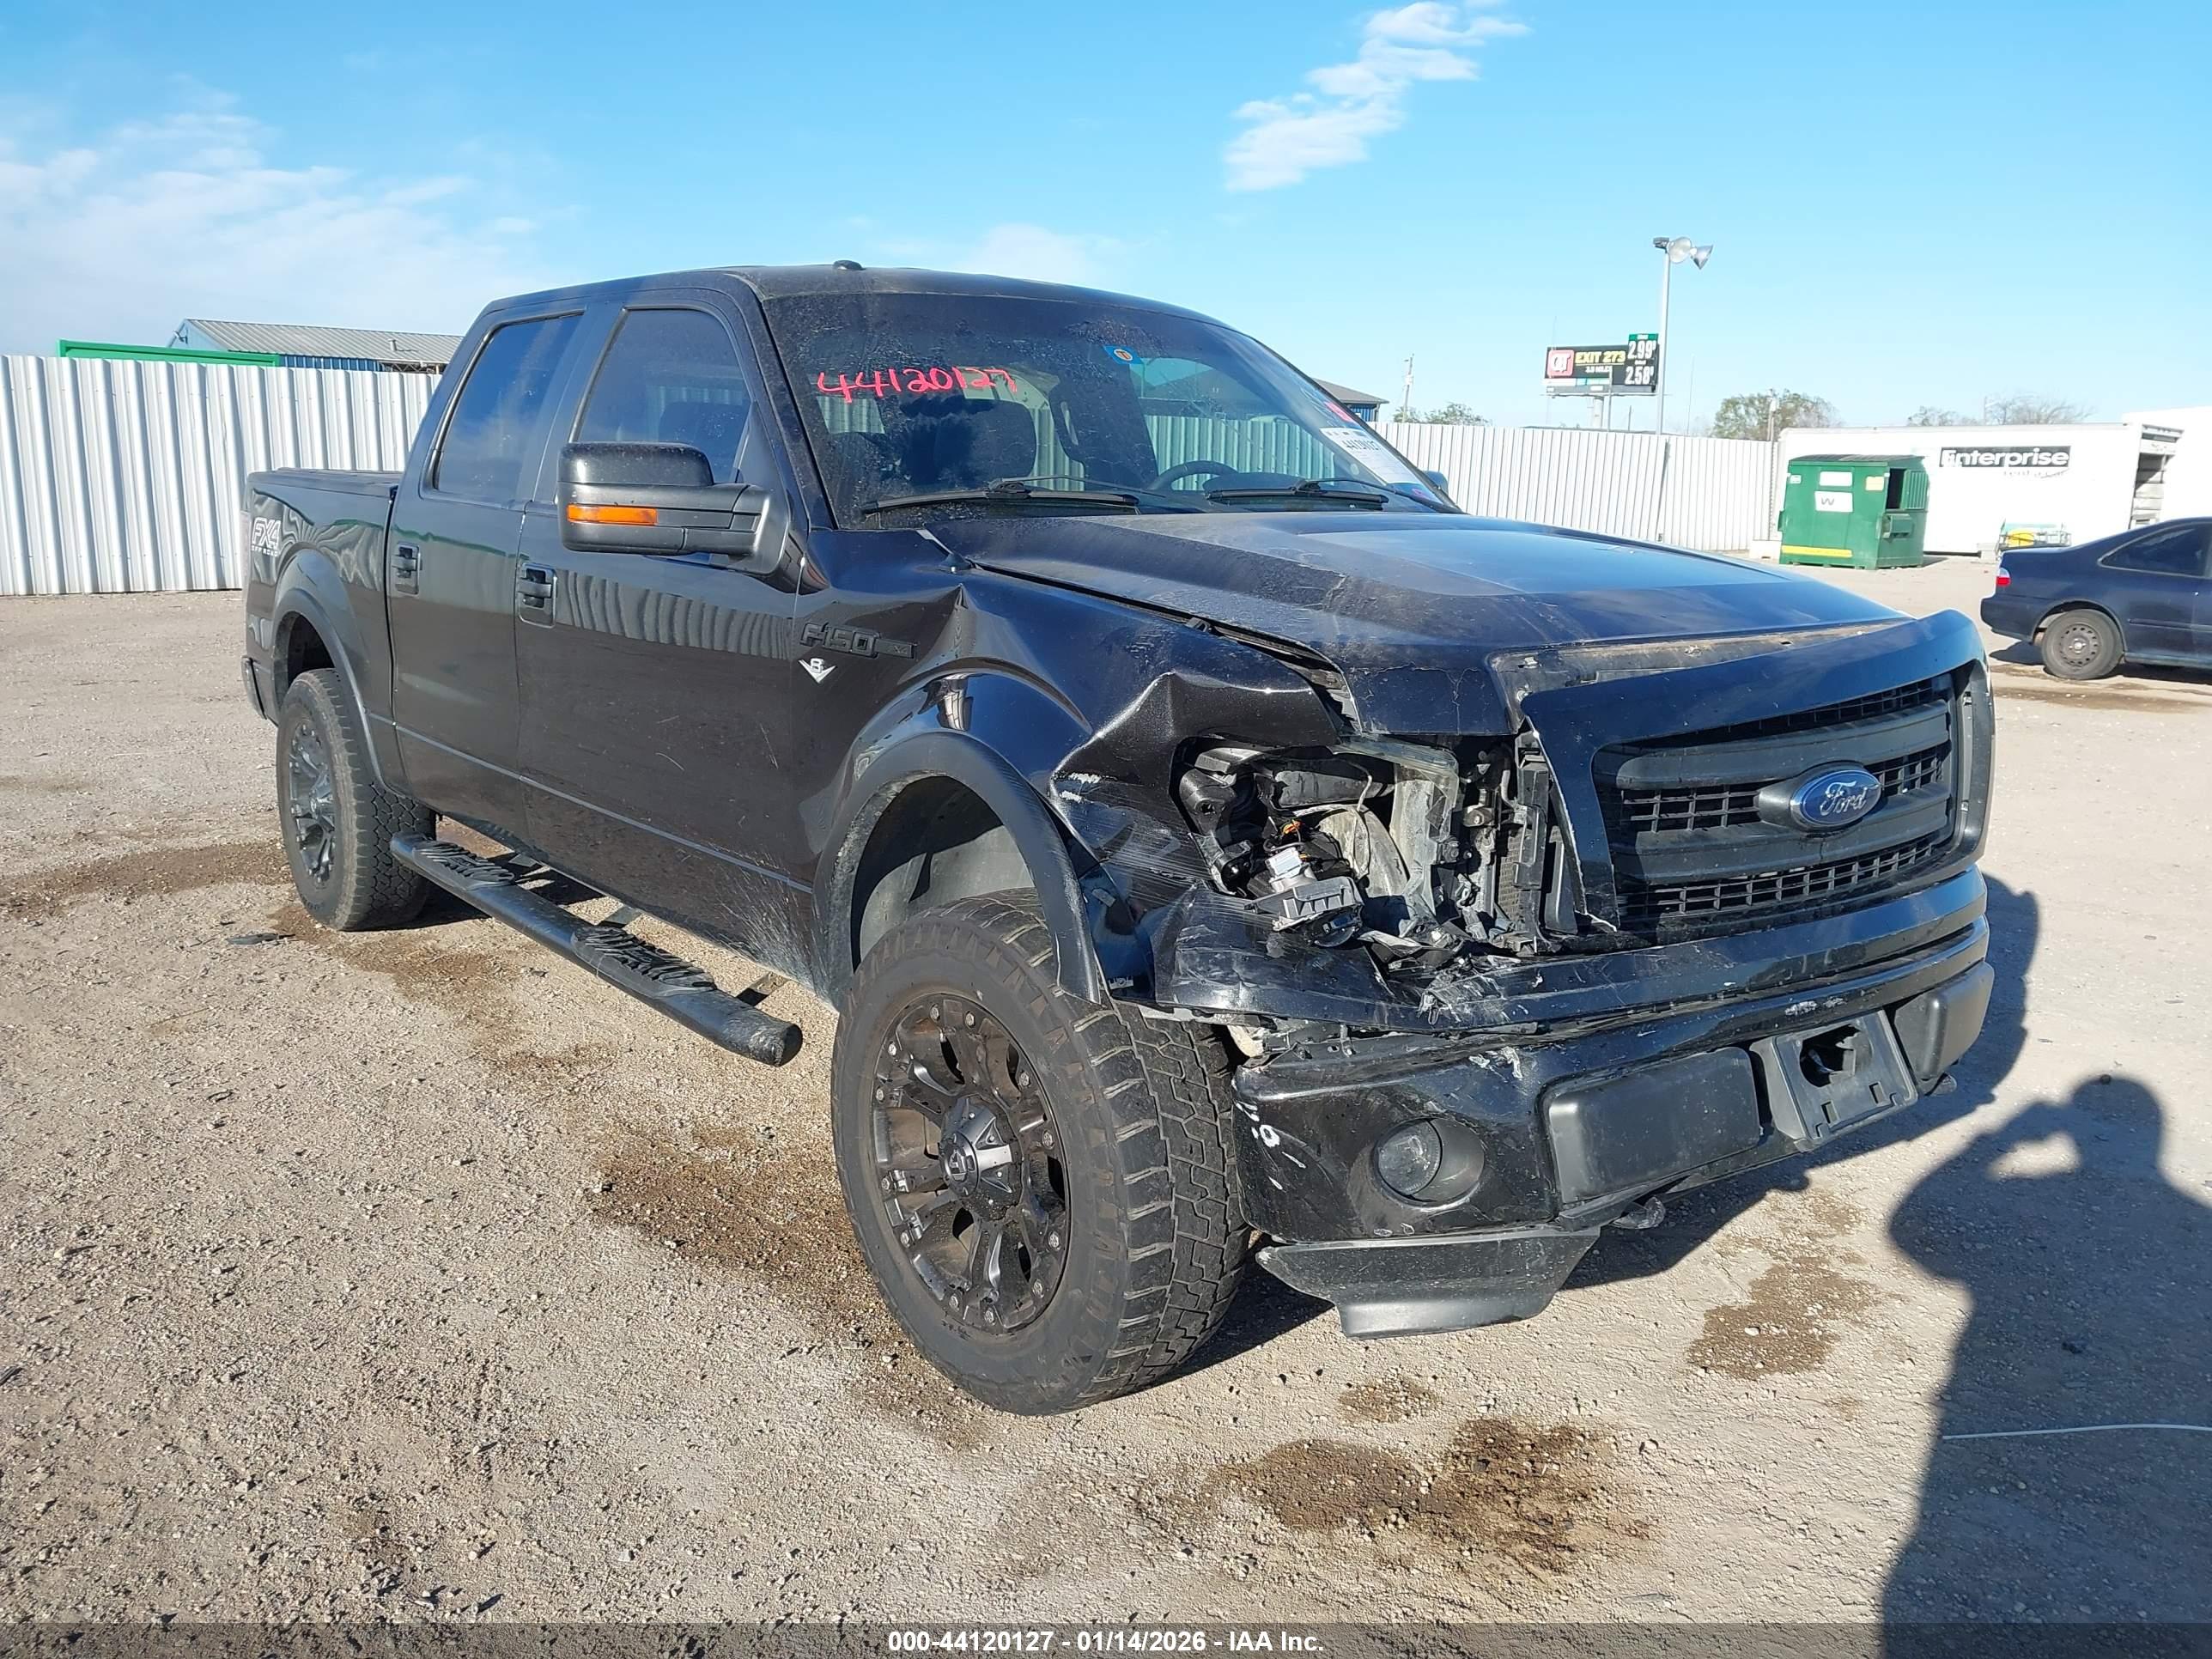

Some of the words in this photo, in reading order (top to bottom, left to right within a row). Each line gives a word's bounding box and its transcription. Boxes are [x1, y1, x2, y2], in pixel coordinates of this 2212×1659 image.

[1575, 350, 1601, 364] EXIT
[1602, 350, 1626, 363] 273
[817, 366, 1018, 404] 44120127
[1942, 447, 2070, 468] Enterprise
[252, 517, 281, 550] FX4
[1820, 781, 1868, 817] Ford
